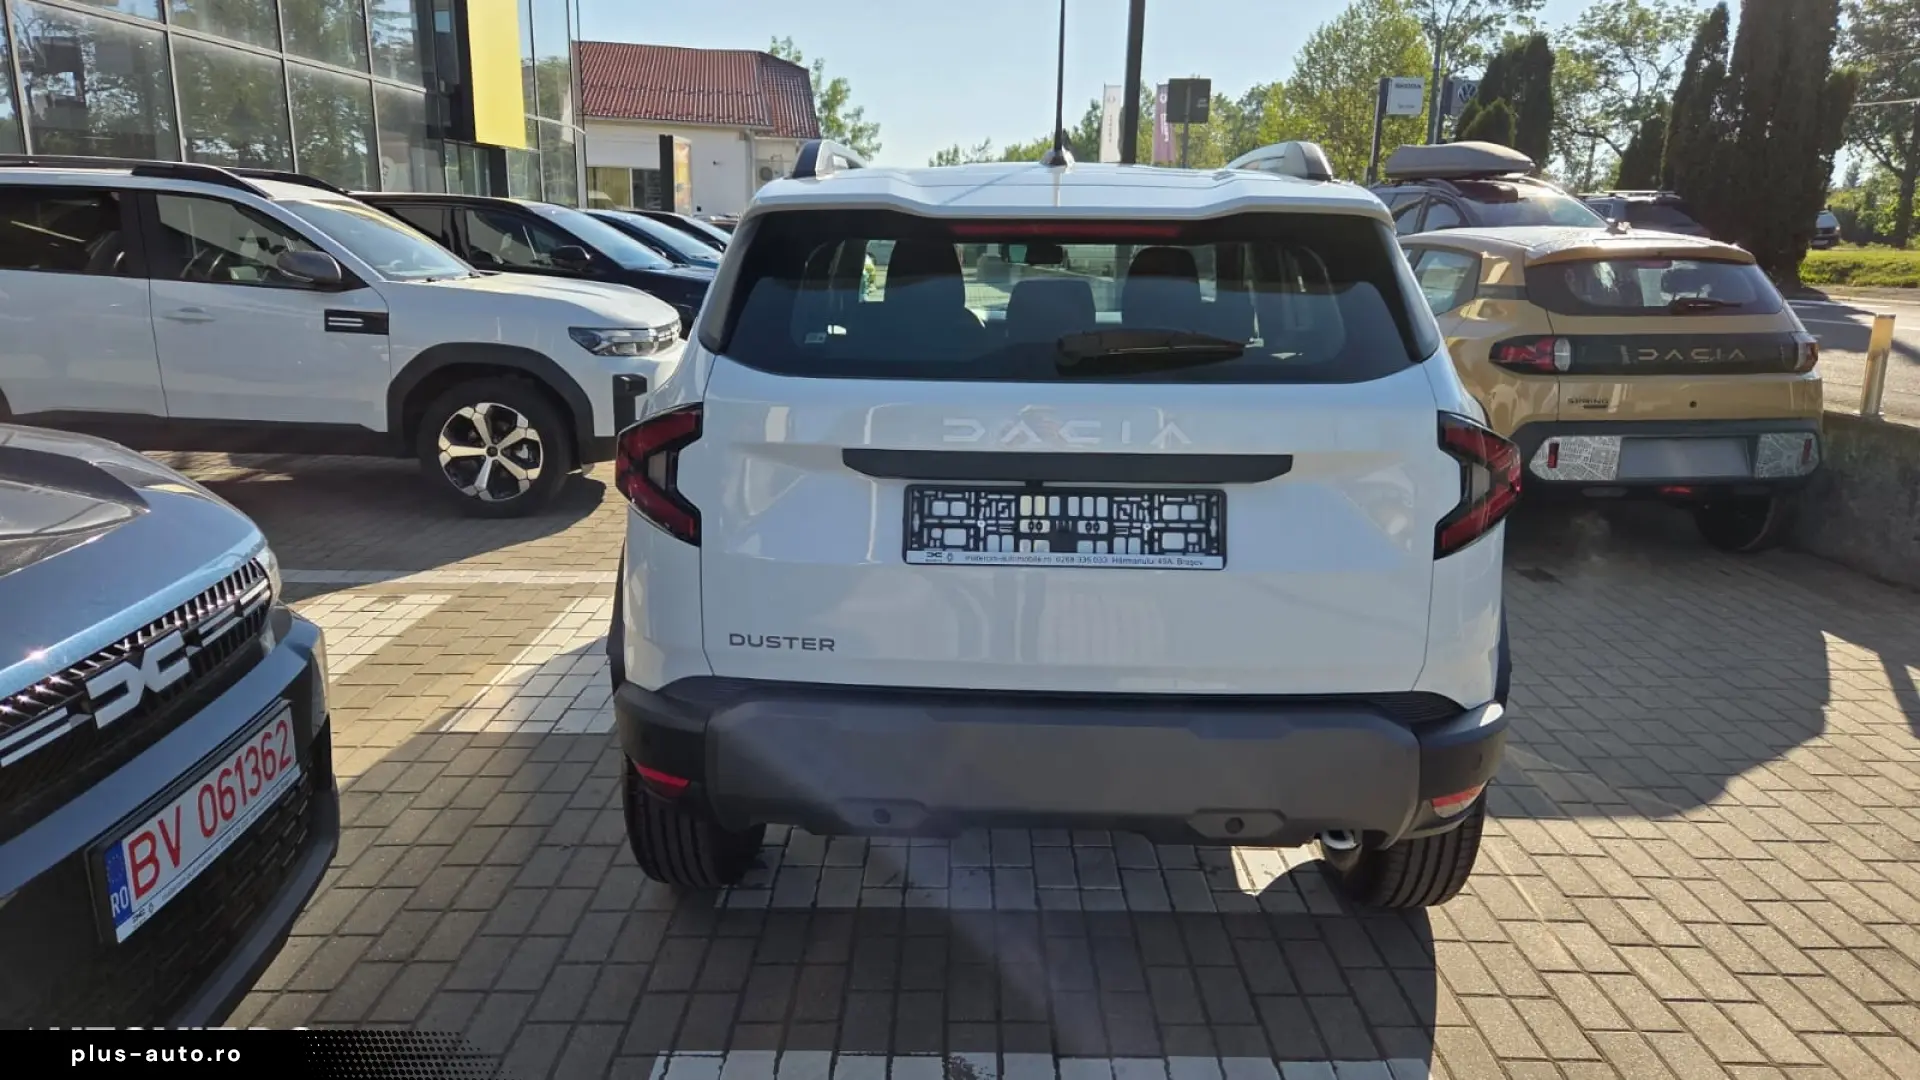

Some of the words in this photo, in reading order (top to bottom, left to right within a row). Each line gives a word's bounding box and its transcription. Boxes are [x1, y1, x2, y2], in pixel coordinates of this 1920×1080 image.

[1637, 347, 1746, 362] DACIA
[943, 417, 1193, 445] DACIA
[729, 632, 836, 652] DUSTER
[128, 804, 182, 901] BV
[197, 719, 292, 839] 061362
[111, 889, 130, 918] RO
